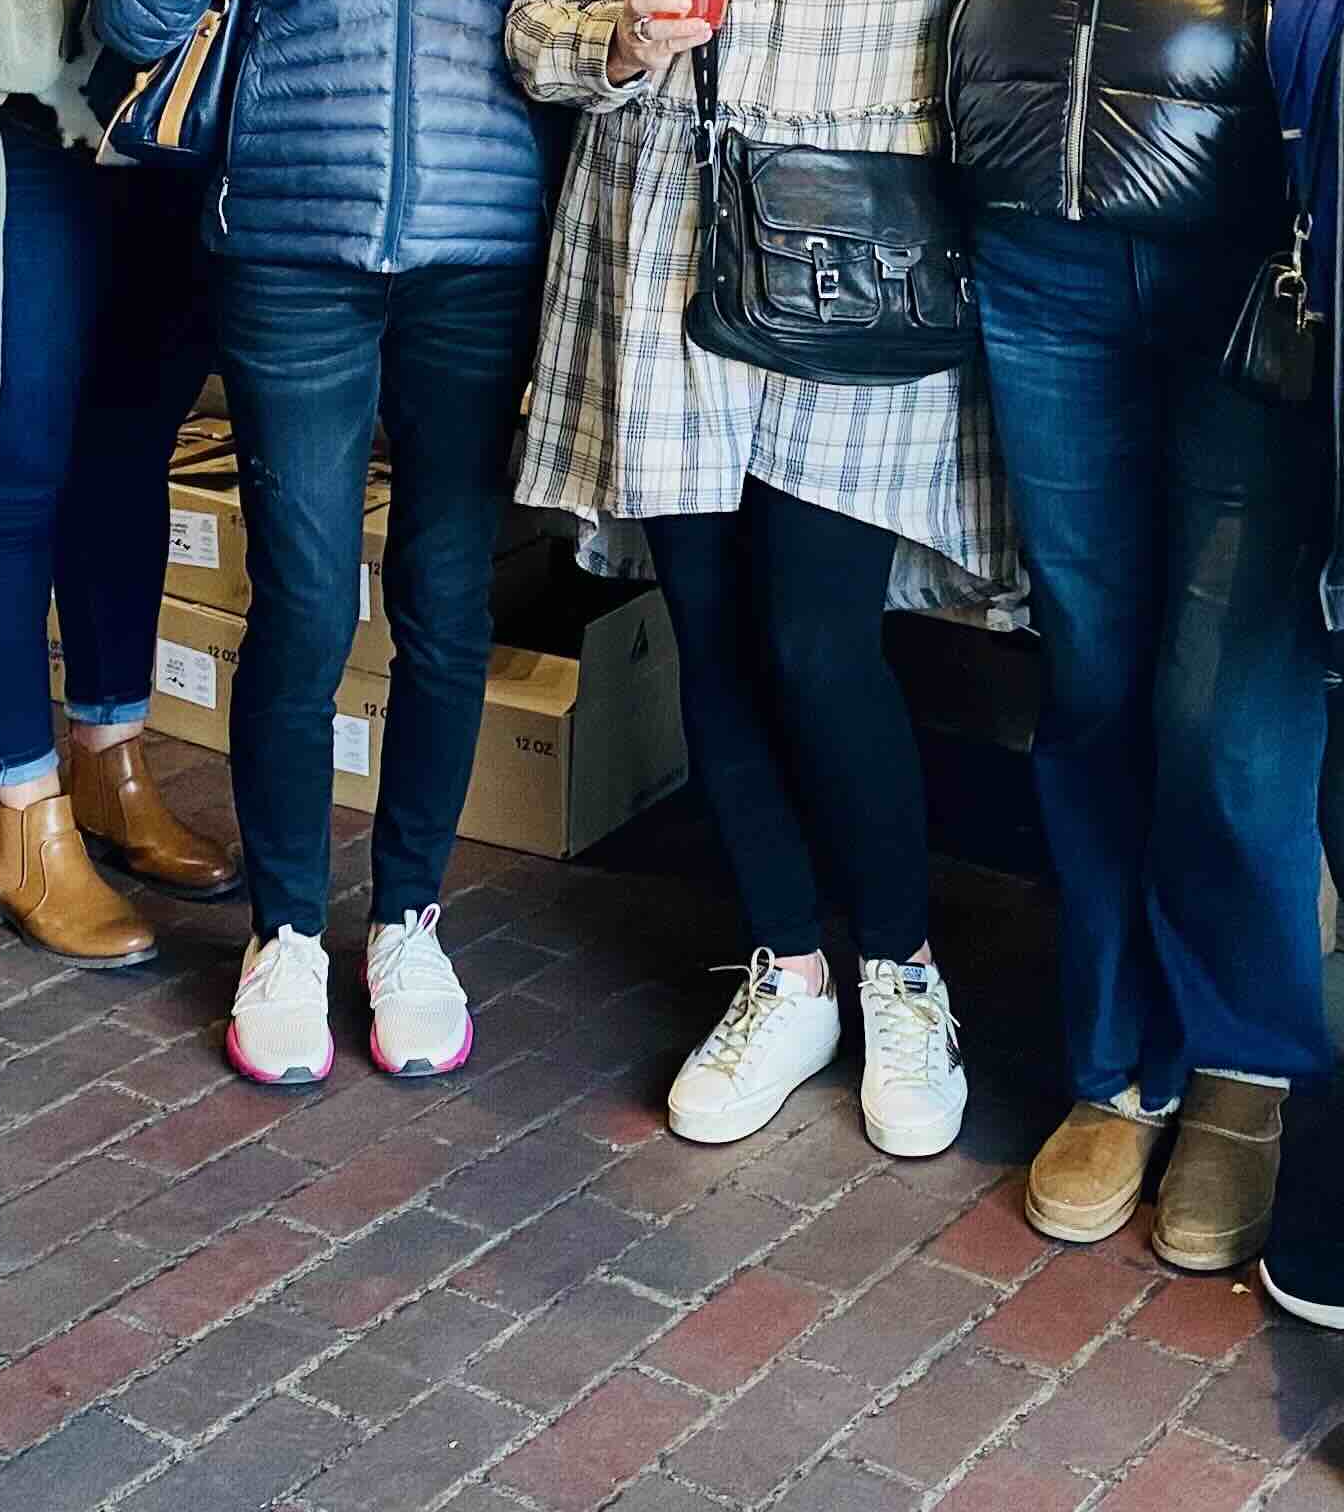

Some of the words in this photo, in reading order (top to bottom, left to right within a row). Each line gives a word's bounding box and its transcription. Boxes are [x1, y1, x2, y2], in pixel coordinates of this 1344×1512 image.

[208, 644, 220, 658] 12
[364, 701, 377, 717] 12
[514, 735, 531, 751] 12
